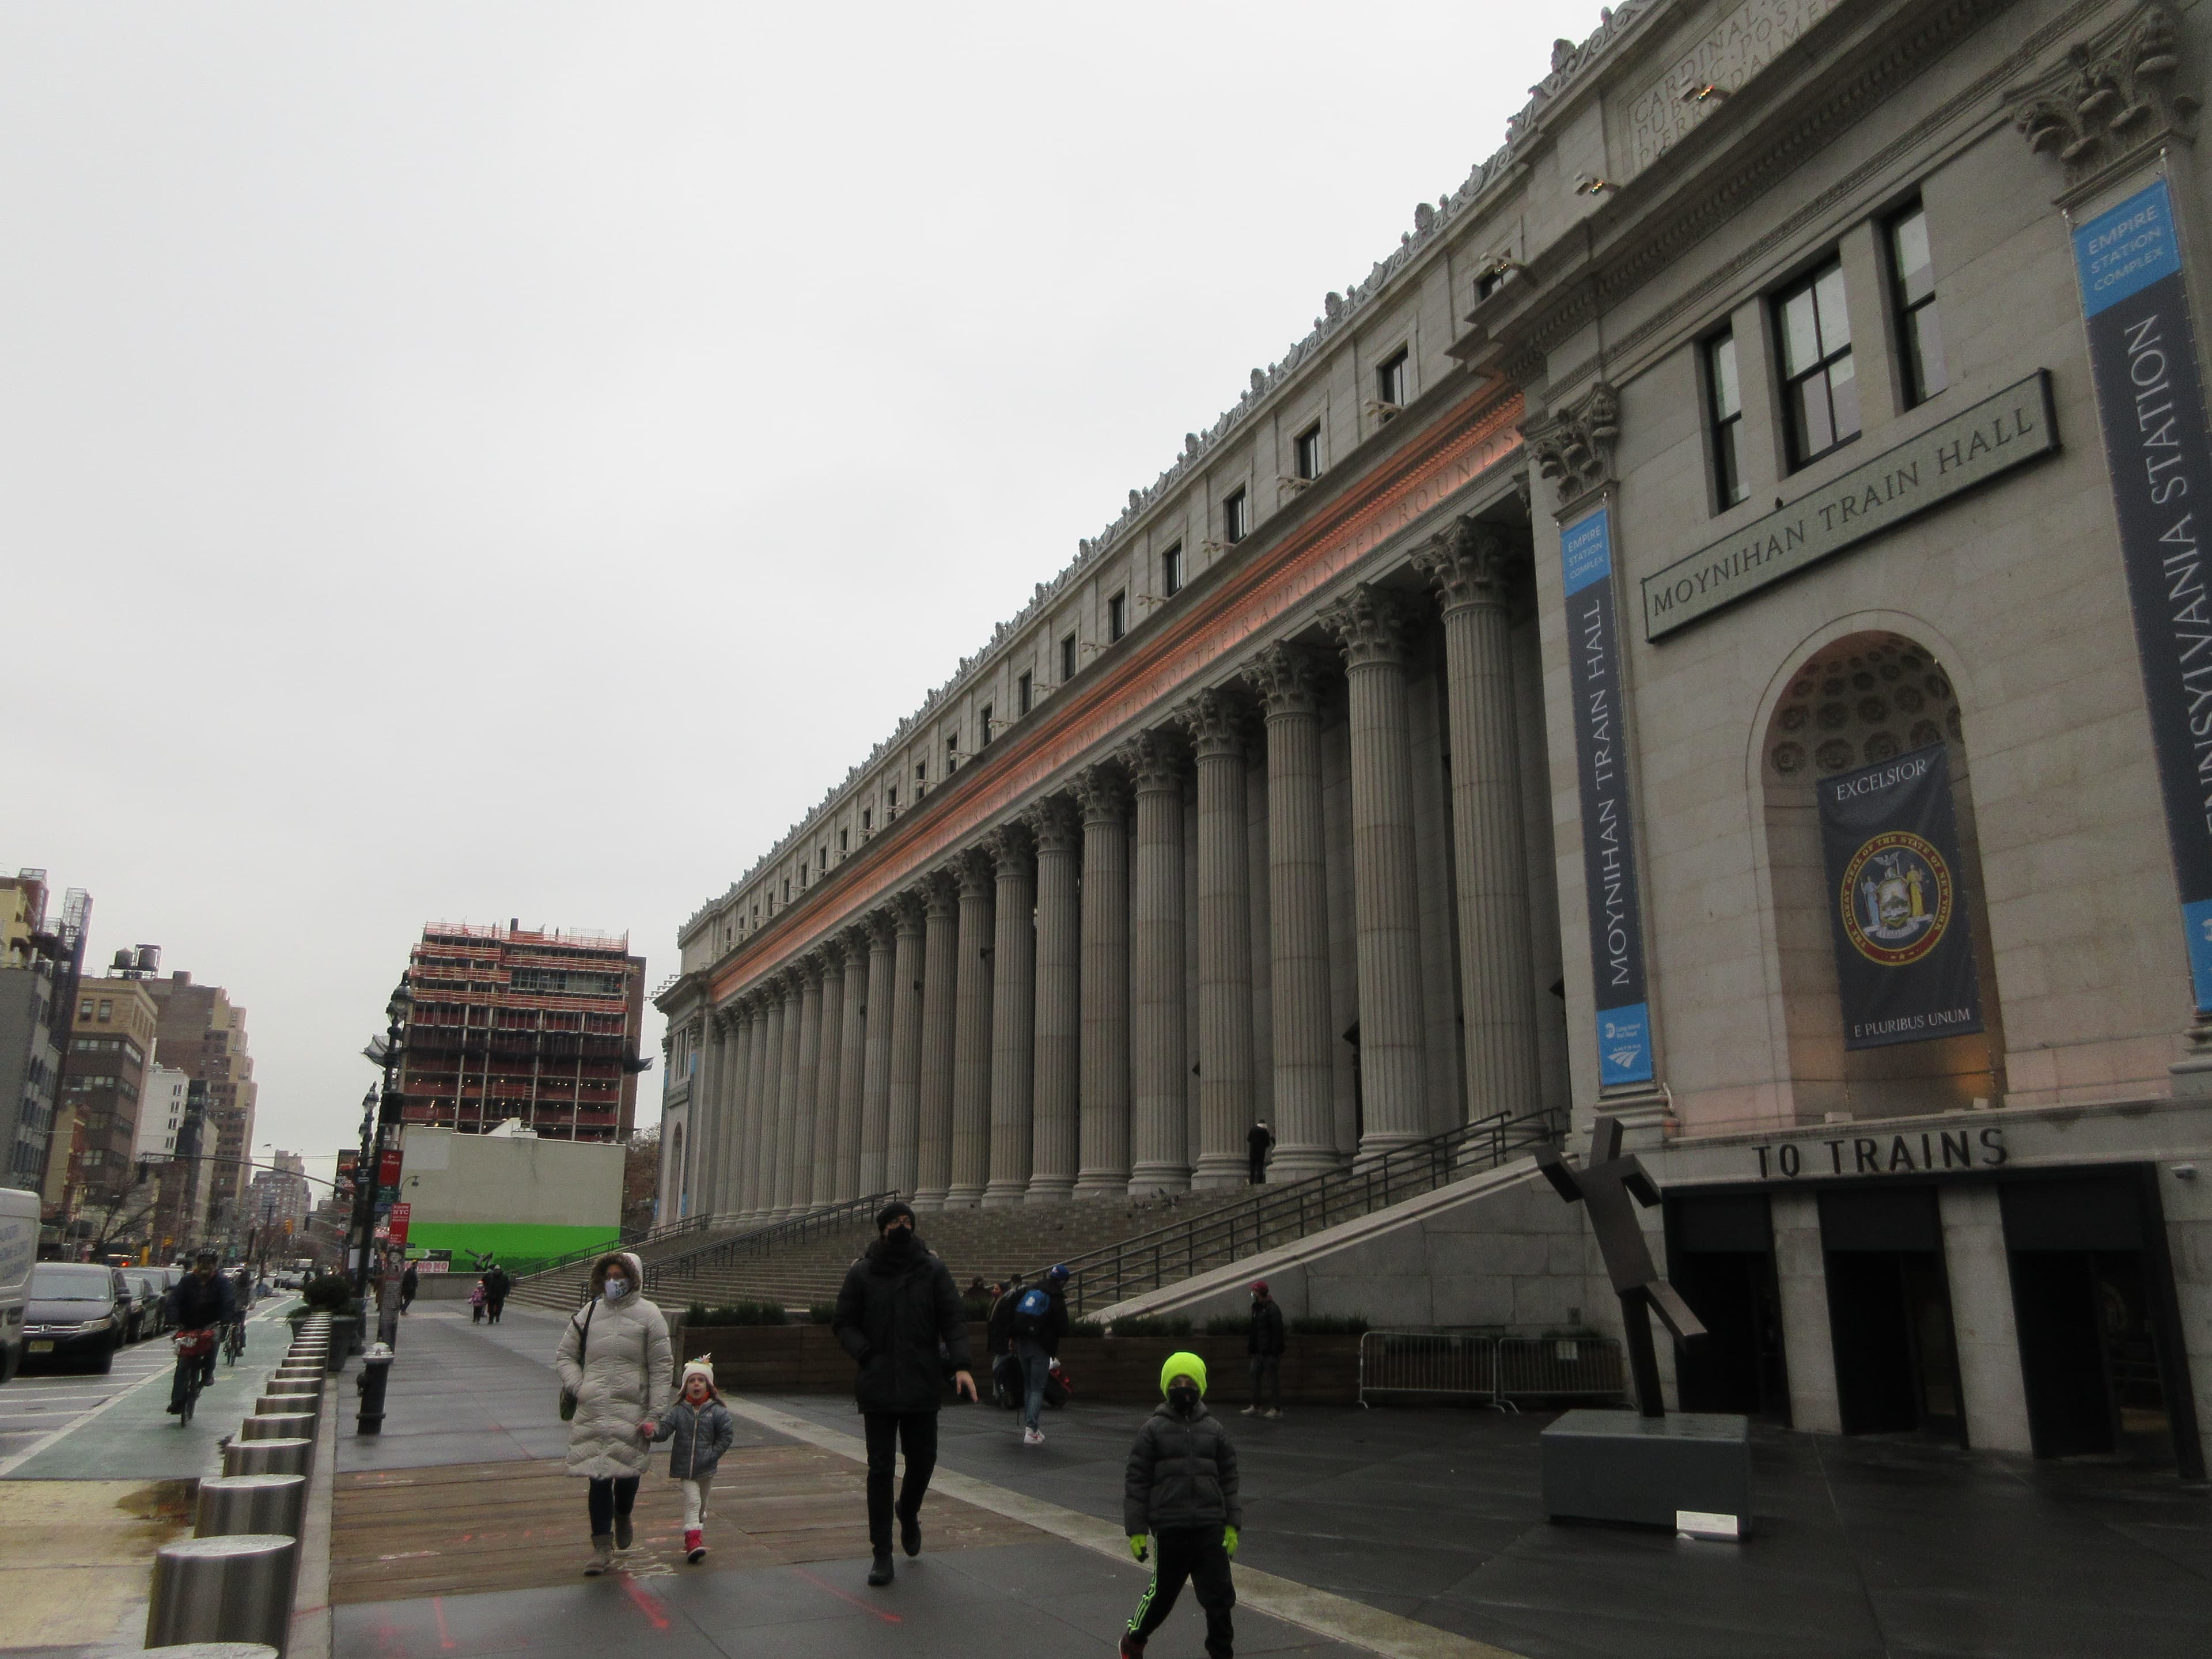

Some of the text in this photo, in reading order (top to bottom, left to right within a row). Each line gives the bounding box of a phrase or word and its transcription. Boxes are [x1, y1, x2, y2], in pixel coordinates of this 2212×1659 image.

[1638, 56, 1726, 149] PUBC
[2089, 206, 2158, 255] EMPIRE
[2092, 226, 2161, 274] STATION
[2094, 247, 2164, 291] COMPLEX
[2124, 315, 2187, 504] STATION
[1653, 407, 2035, 616] MOYNIHAN TRAIN HALL
[1168, 661, 1185, 687] OF
[1195, 617, 1251, 668] THEIR
[1260, 522, 1382, 627] APPOINTED
[1398, 426, 1513, 527] ROUNDS
[1568, 525, 1601, 552] EMPIRE
[1569, 541, 1603, 567] STATION
[1570, 555, 1604, 579] COMPLEX
[1584, 600, 1629, 986] MOYNIHAN TRAIN HALL
[1837, 759, 1926, 800] EXCELSIOR
[1876, 836, 1896, 846] THE
[1900, 836, 1930, 854] STATE
[1854, 1008, 1971, 1037] E PLURIBUS UNUM
[1751, 1128, 2008, 1179] TO TRAINS
